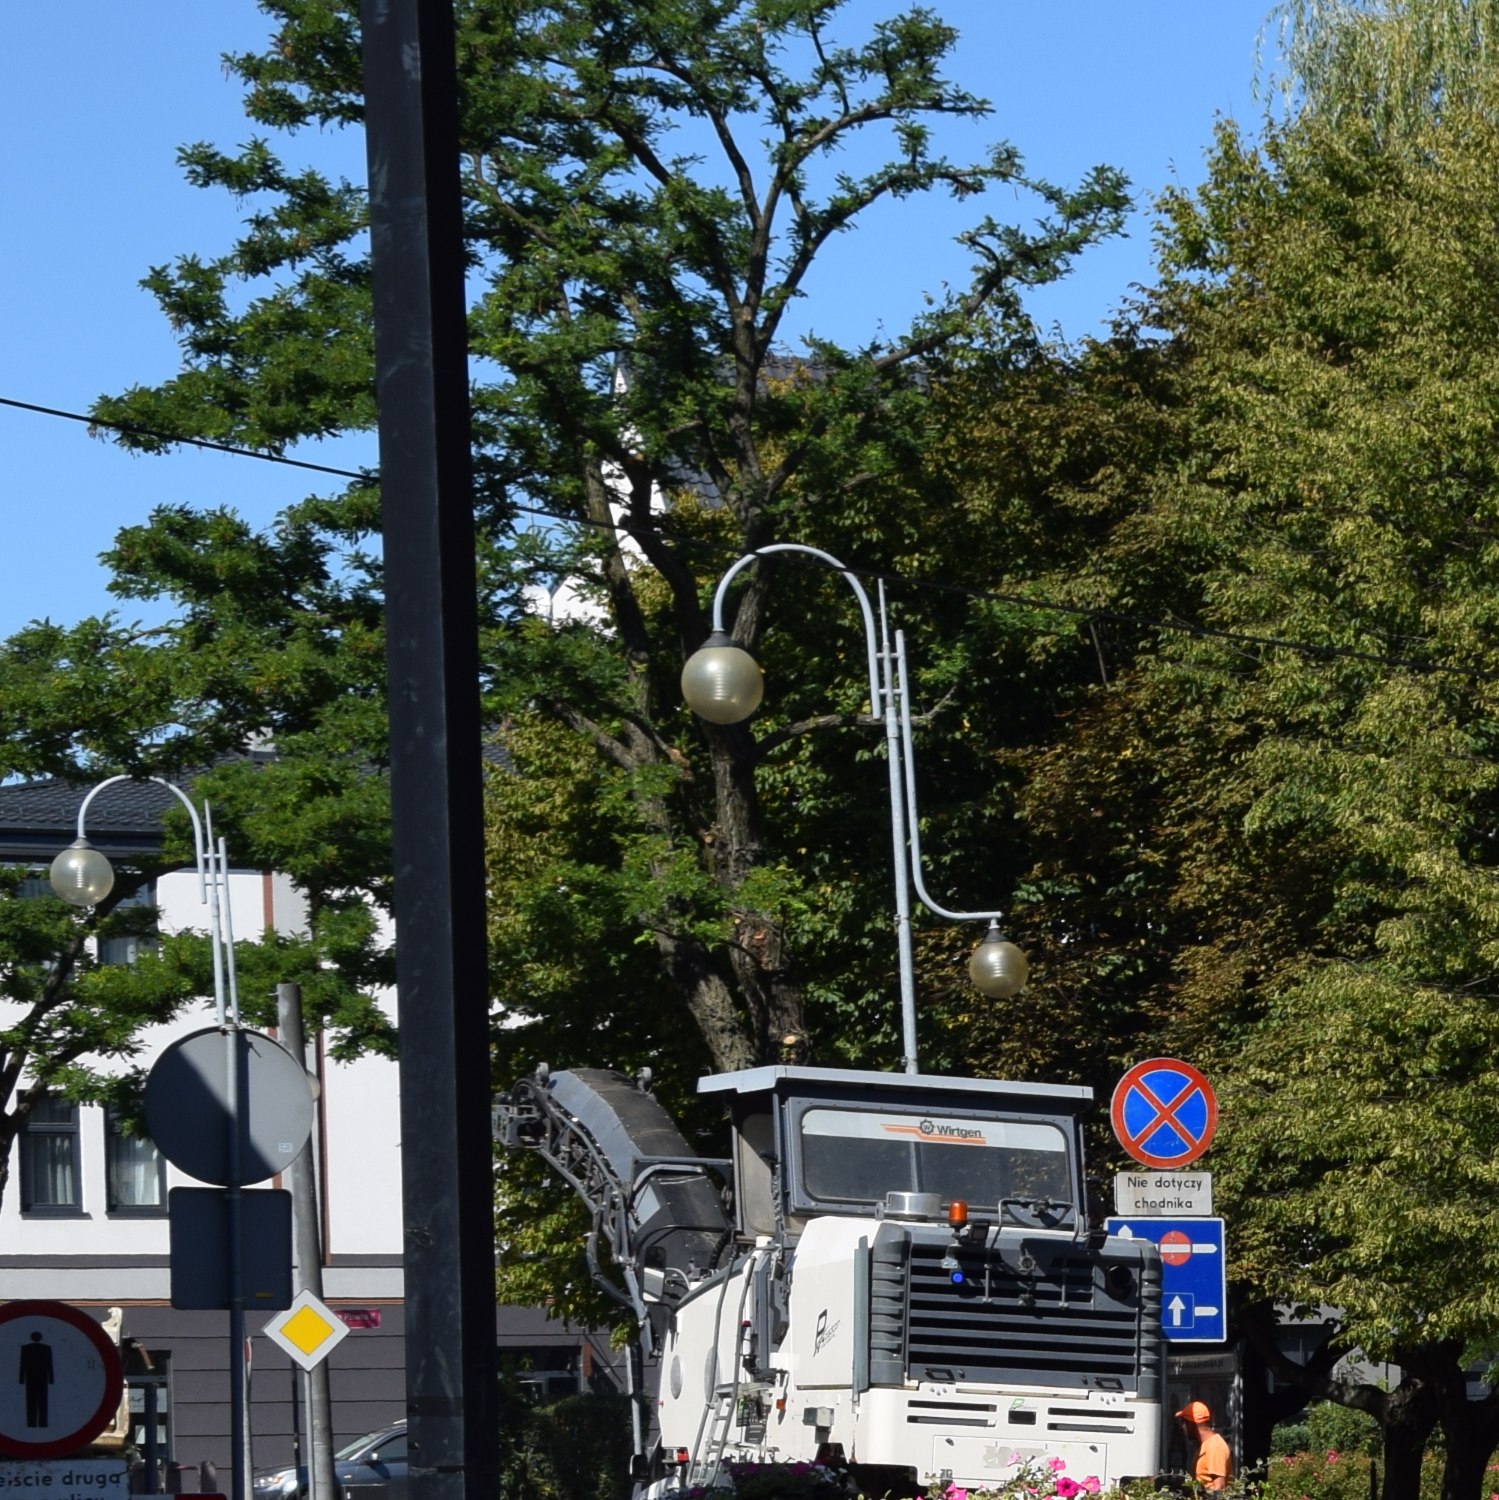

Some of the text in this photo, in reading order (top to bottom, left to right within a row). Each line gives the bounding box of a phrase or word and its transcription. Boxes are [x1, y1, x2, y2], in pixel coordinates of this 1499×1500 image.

[937, 1125, 982, 1138] Wirtgen
[1127, 1177, 1203, 1192] Nie dotyczy
[1134, 1197, 1193, 1209] chodnika
[62, 1470, 121, 1488] drugą
